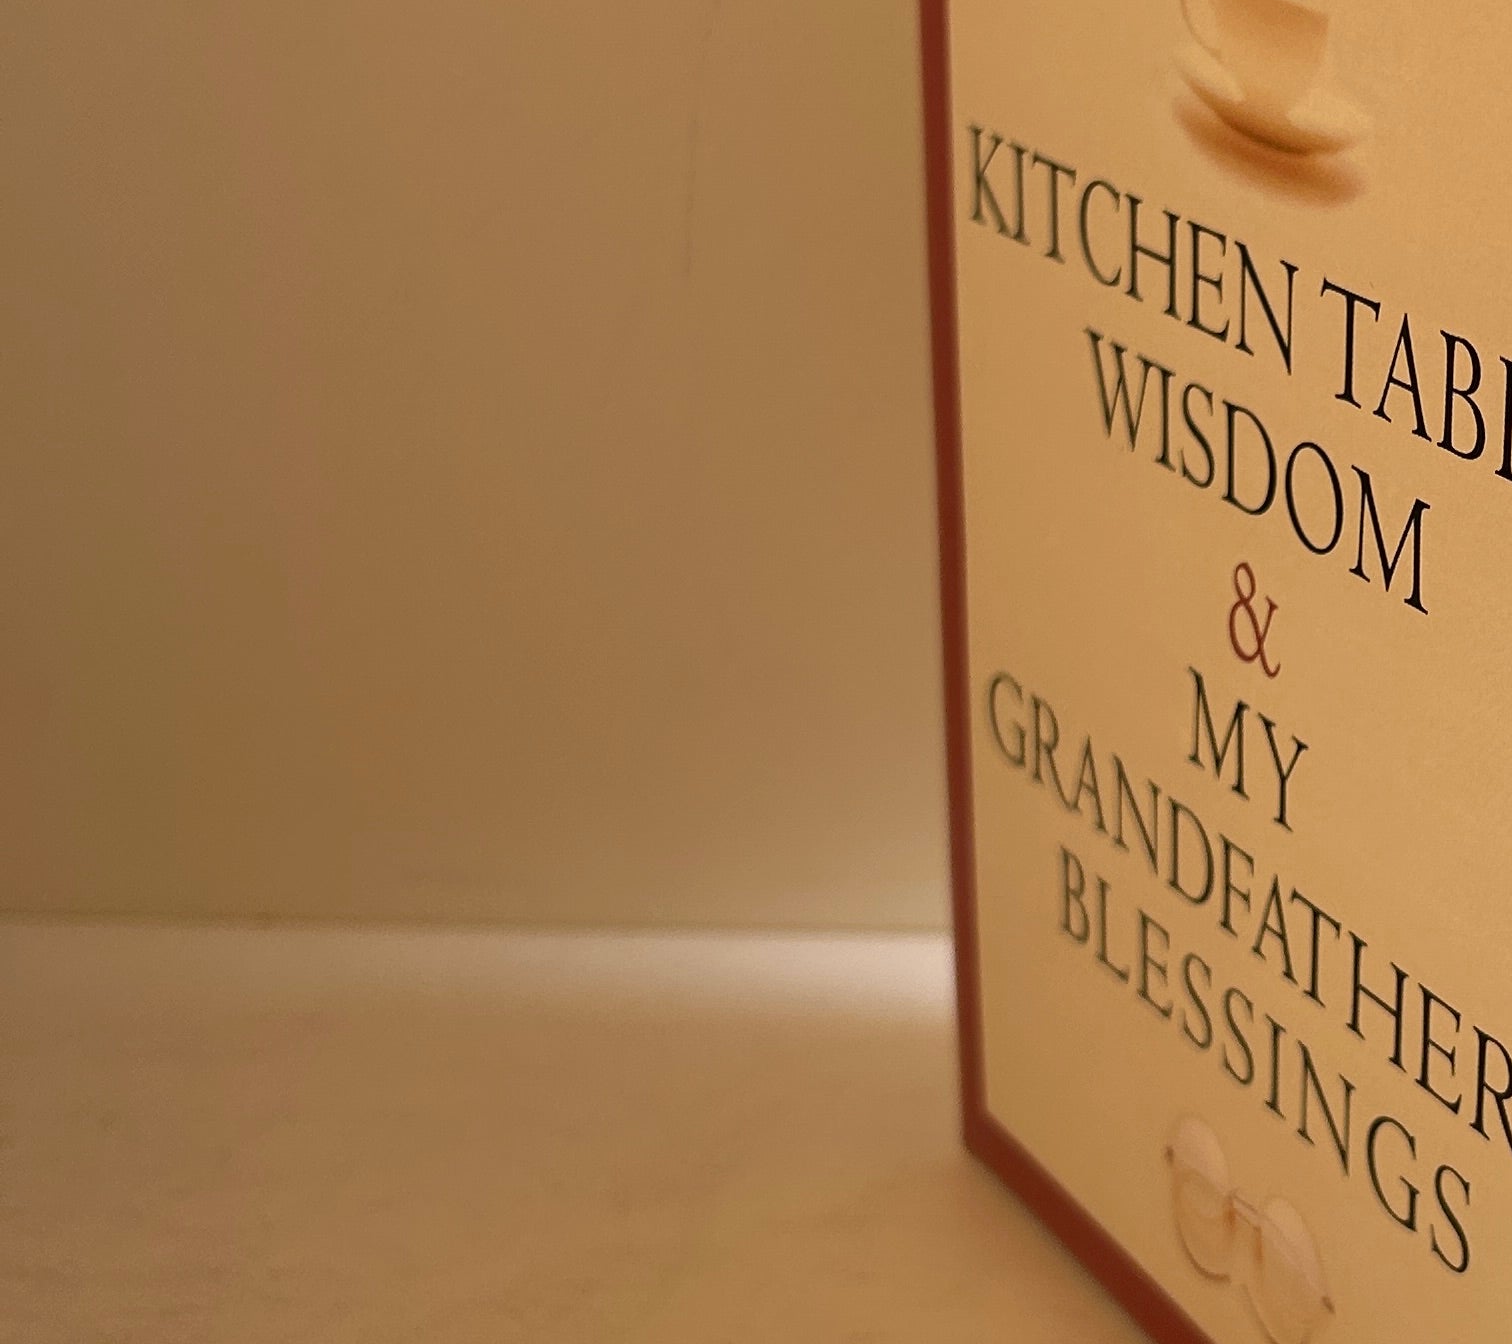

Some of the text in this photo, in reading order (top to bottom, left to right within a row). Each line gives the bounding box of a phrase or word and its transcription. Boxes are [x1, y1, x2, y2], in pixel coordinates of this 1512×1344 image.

[967, 123, 1299, 375] KITCHEN
[1084, 329, 1430, 616] WISDOM
[1228, 563, 1280, 678] &
[1188, 666, 1308, 832] MY
[1060, 846, 1471, 1275] BLESSINGS
